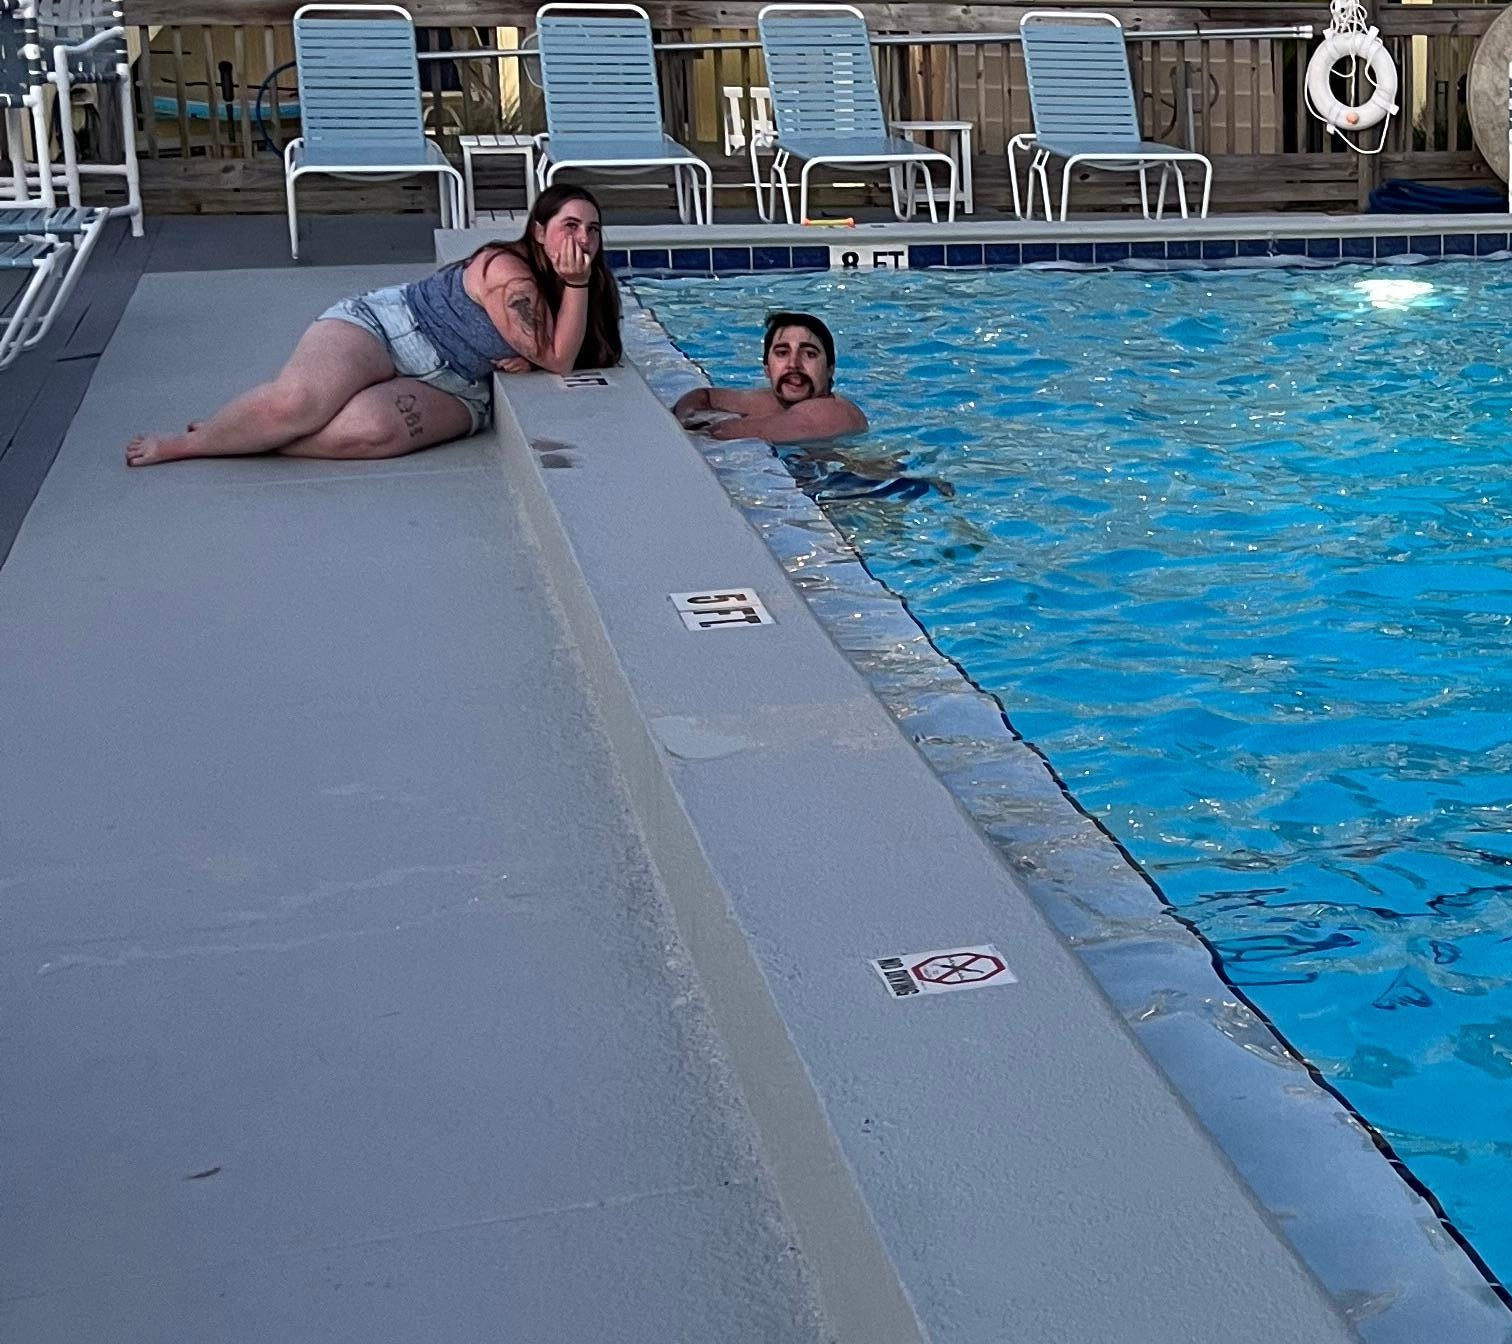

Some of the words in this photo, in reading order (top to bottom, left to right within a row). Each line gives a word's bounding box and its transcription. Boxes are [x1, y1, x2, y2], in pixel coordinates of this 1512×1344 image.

[872, 251, 904, 269] FT
[687, 593, 747, 604] 5
[877, 957, 904, 969] NO
